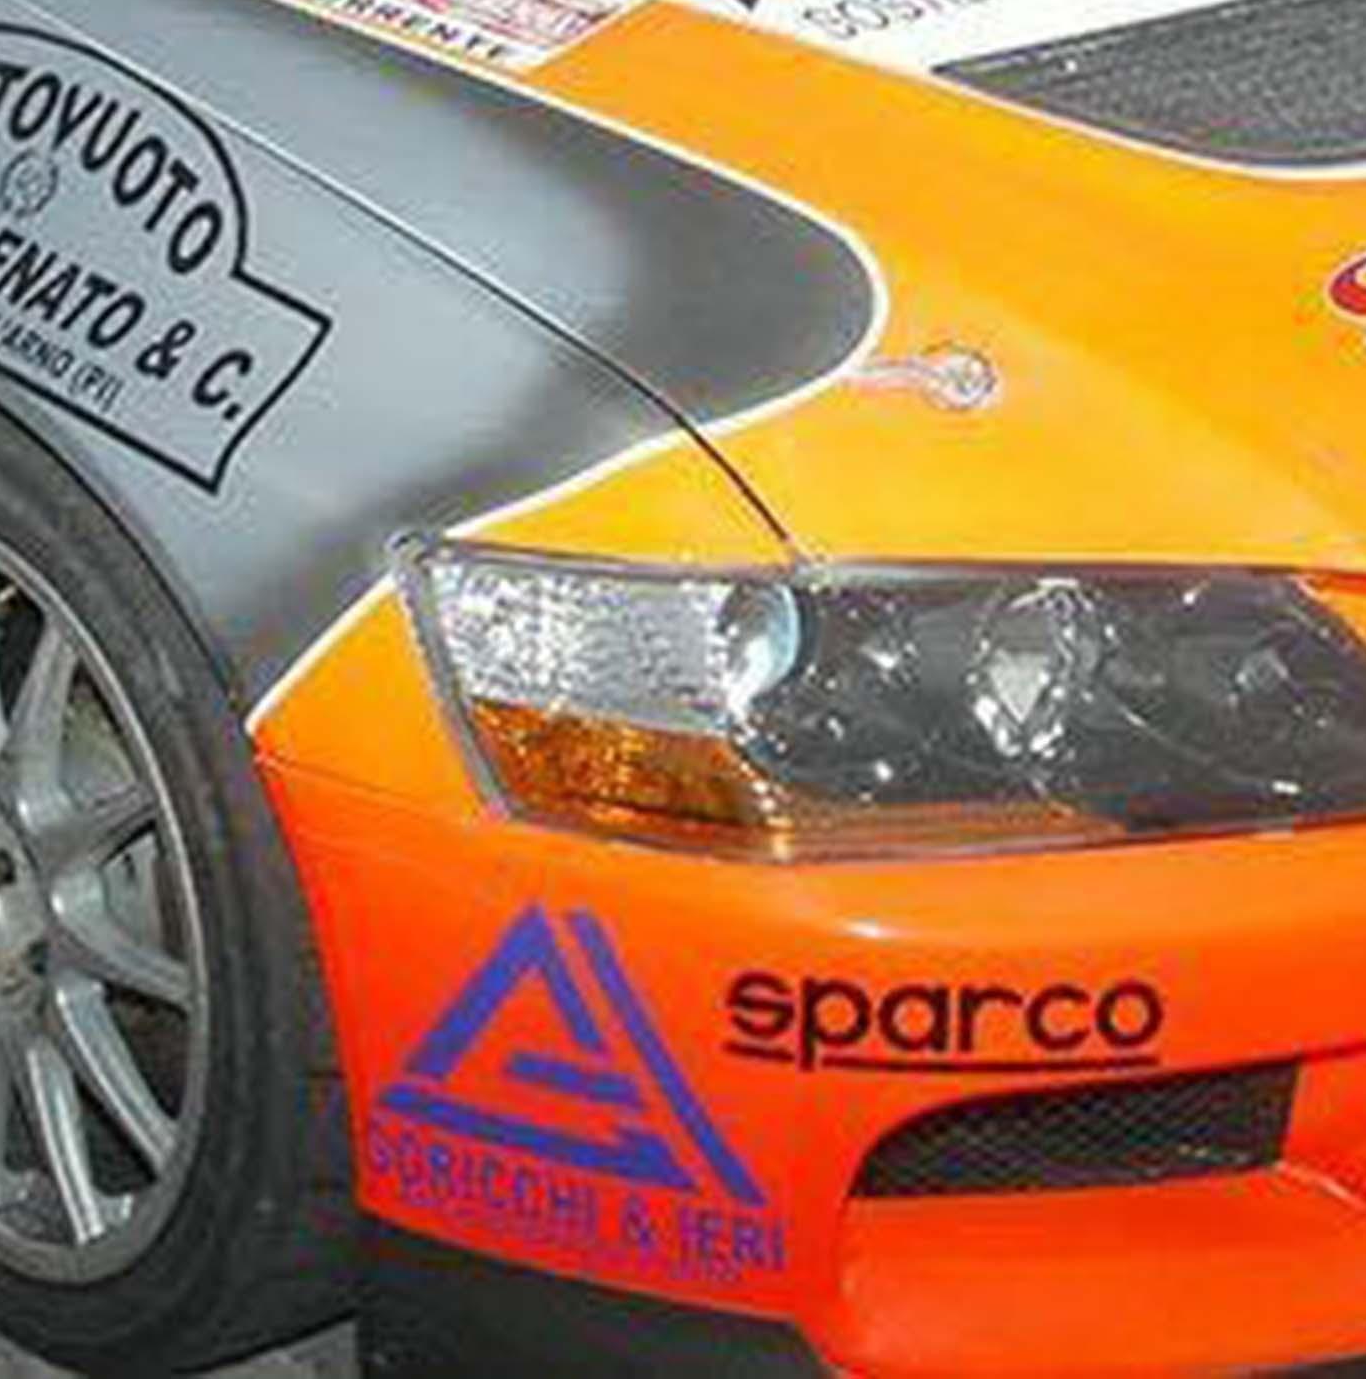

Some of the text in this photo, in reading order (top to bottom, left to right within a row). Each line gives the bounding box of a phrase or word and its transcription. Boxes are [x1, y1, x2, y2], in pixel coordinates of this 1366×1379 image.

[136, 320, 196, 382] &
[193, 350, 252, 420] C.
[724, 969, 1165, 1072] sparco
